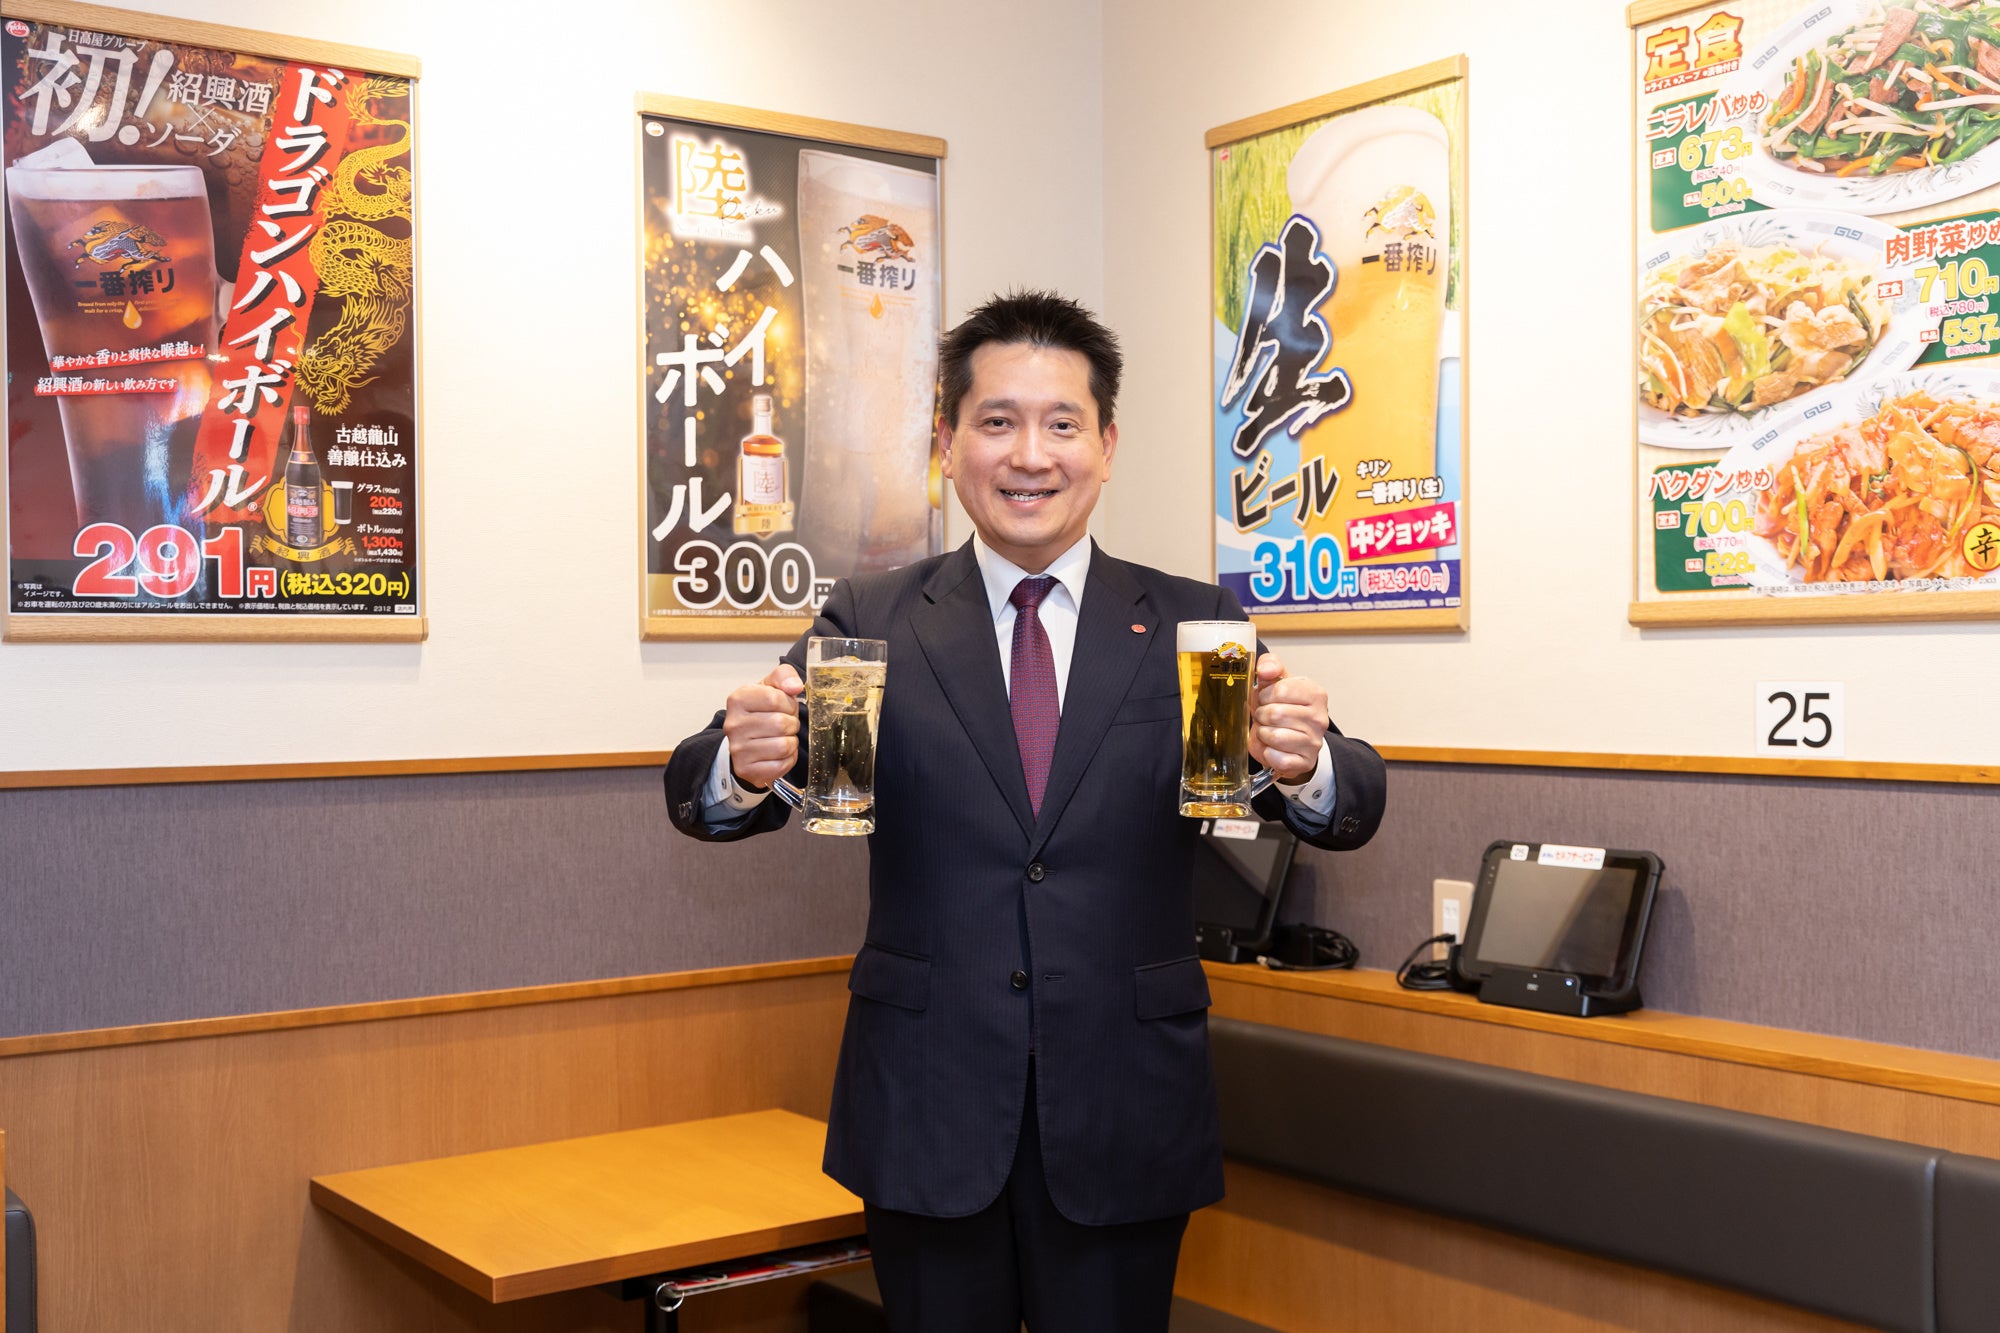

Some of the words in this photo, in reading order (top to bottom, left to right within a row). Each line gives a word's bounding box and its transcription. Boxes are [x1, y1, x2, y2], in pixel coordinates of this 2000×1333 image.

[1643, 11, 1743, 82] 定食
[167, 69, 274, 116] 紹興酒
[1645, 91, 1766, 139] ニラレバ炒め
[146, 121, 243, 158] ソーダ
[1679, 127, 1753, 171] 673円
[675, 139, 746, 221] 陸
[1701, 178, 1753, 208] 500円
[837, 260, 916, 291] 一番搾り
[1362, 243, 1437, 275] 一番搾り
[75, 268, 175, 296] 一番搾り
[190, 66, 347, 515] ドラゴンハイボール
[1914, 258, 2000, 303] 710円
[716, 245, 795, 387] ハイ
[1925, 296, 1989, 319] (税込780円)
[1222, 213, 1354, 457] 生
[1943, 313, 2000, 346] 537円
[37, 377, 178, 393] 紹興酒の新しい飲み方です
[336, 427, 399, 446] 古越龍山
[652, 322, 733, 542] ボール
[1356, 459, 1392, 479] キリン
[1649, 468, 1772, 500] バクダン炒め
[369, 496, 403, 509] 200円
[1231, 450, 1342, 535] ビール
[1356, 476, 1445, 505] 一番搾り(生)
[1349, 511, 1452, 555] 中ジョッキ
[1682, 500, 1755, 537] 700円
[73, 522, 278, 598] 291円
[280, 570, 410, 600] (税込320円)
[361, 536, 403, 550] 1,300円
[1969, 527, 2000, 565] 辛
[1250, 534, 1359, 602] 310円
[1361, 562, 1450, 598] (税込340円)
[1705, 552, 1756, 576] 528円
[23, 590, 65, 598] イメージです。
[1767, 691, 1832, 748] 25
